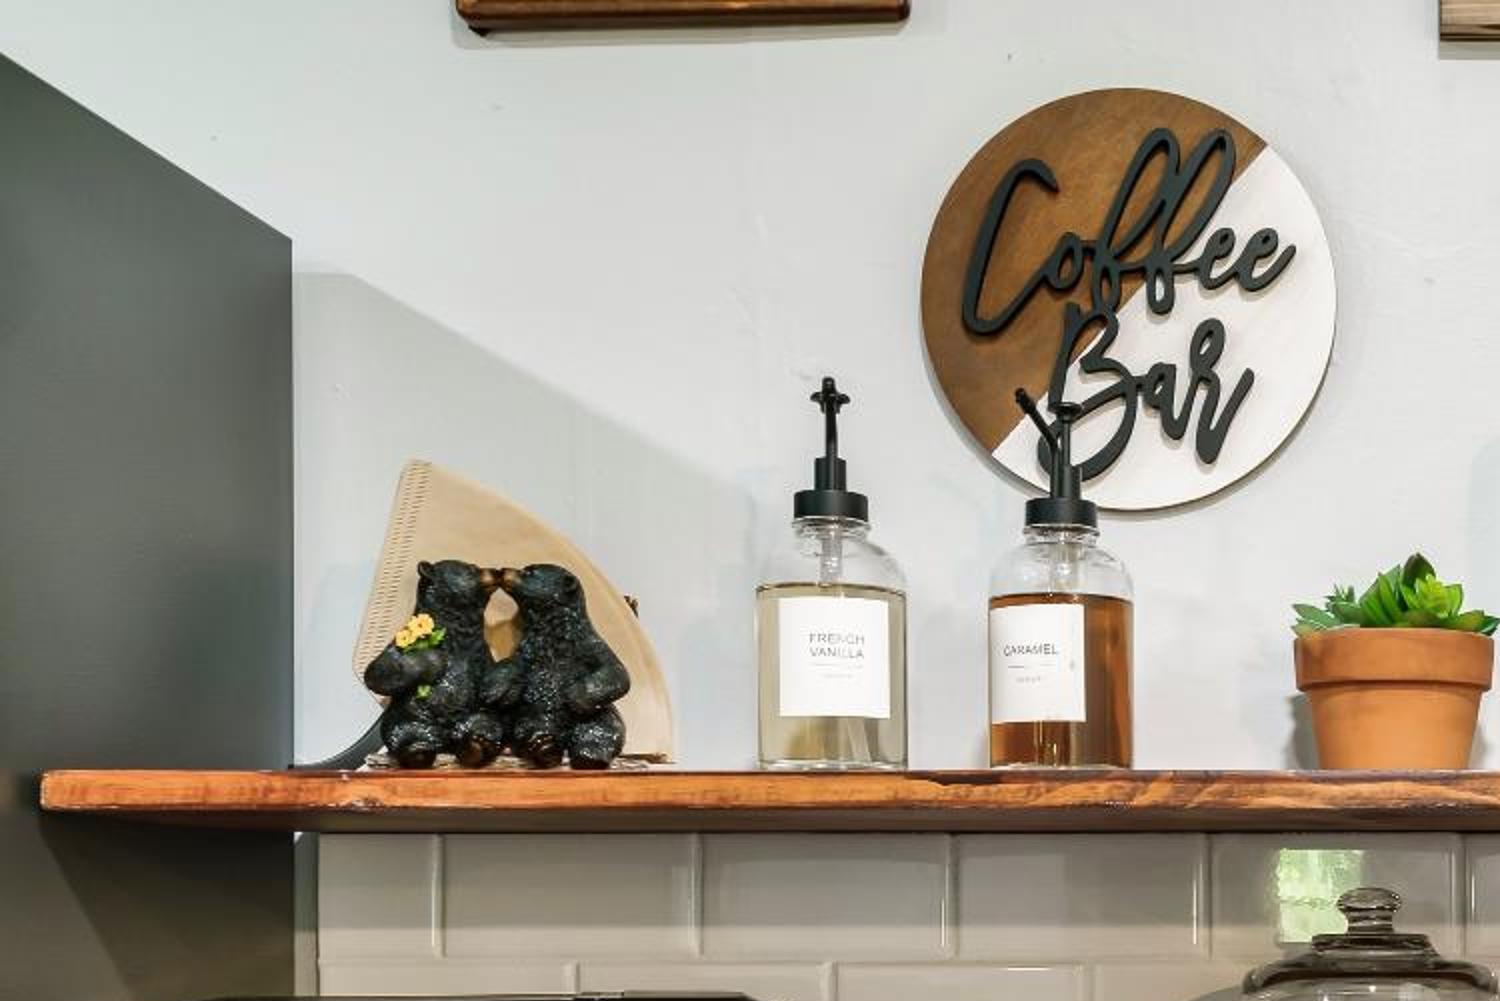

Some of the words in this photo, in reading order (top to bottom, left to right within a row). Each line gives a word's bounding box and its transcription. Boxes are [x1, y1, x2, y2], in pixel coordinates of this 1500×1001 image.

[962, 127, 1297, 336] Coffee
[1037, 302, 1255, 482] Bar
[809, 632, 866, 645] FRENCH
[809, 646, 866, 660] VANILLA
[1003, 642, 1058, 657] CARAMEL
